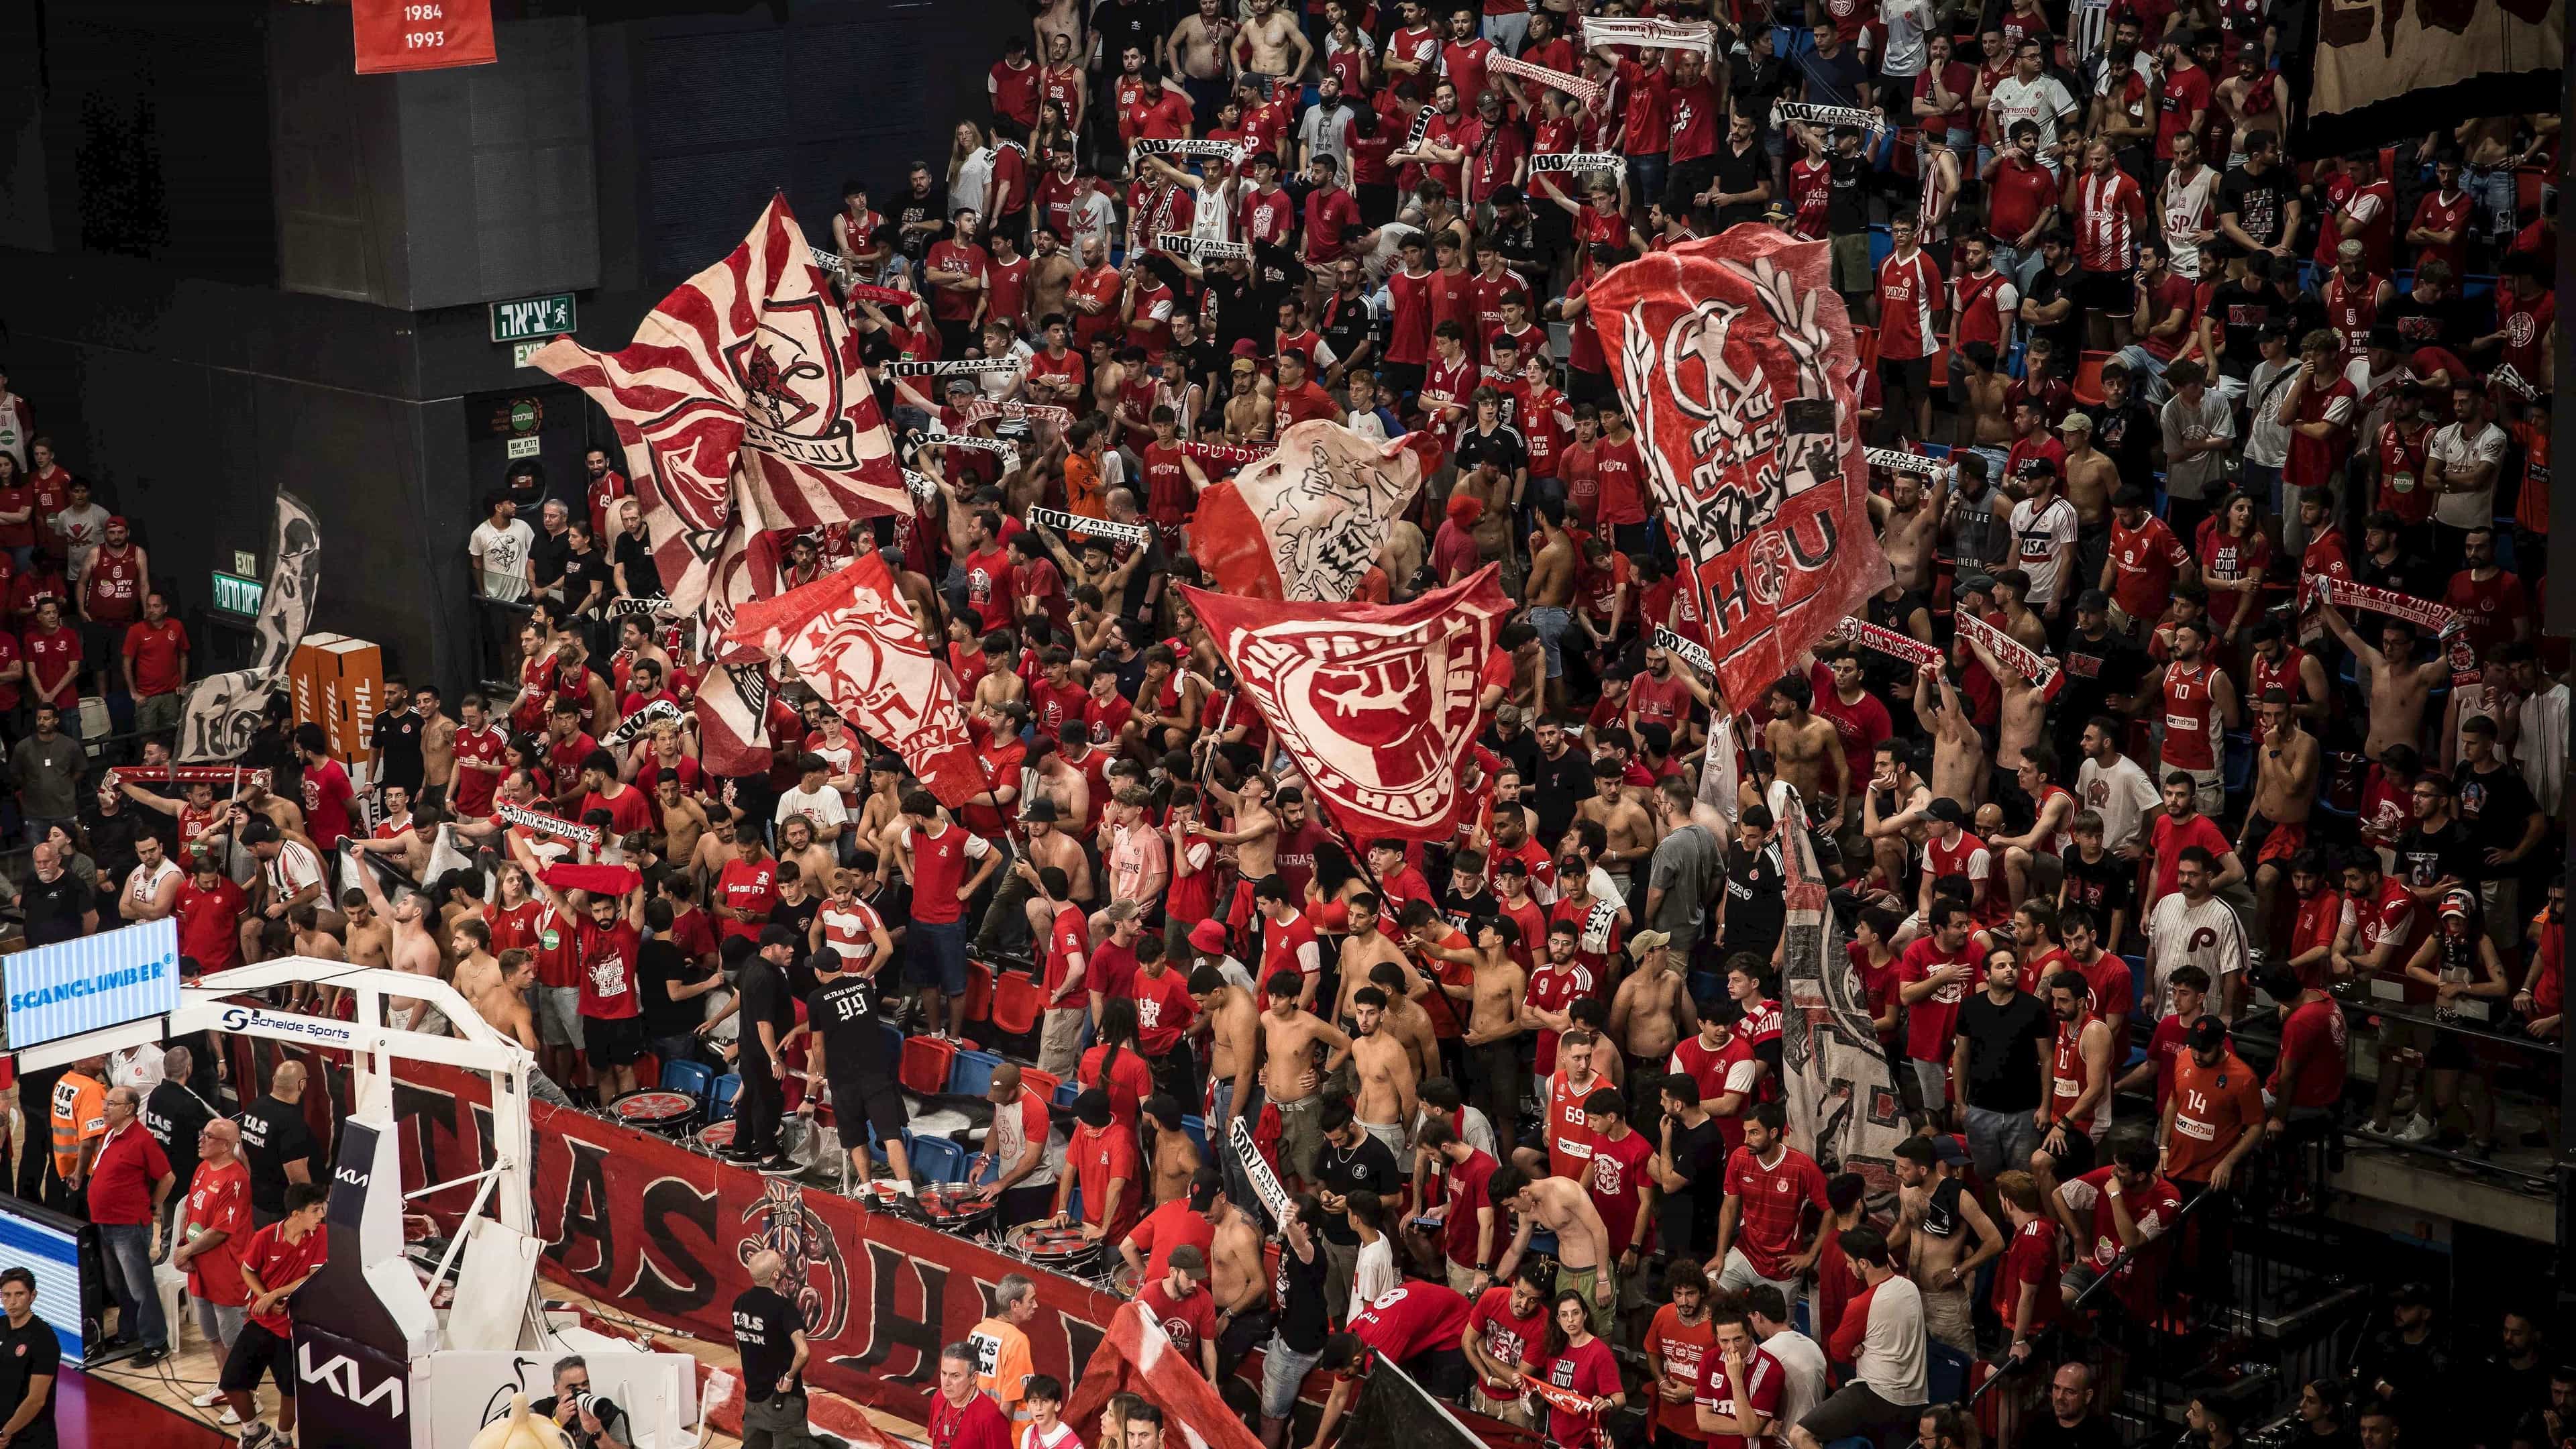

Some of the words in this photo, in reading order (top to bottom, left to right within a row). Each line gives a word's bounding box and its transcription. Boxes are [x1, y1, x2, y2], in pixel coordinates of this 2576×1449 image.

[404, 4, 443, 21] 1984
[405, 31, 444, 48] 1993
[1051, 86, 1064, 98] 32
[1122, 91, 1136, 103] 69
[1244, 136, 1260, 151] SP
[1806, 188, 1828, 199] rkia
[2169, 215, 2191, 233] SP
[858, 235, 865, 246] 5
[1205, 241, 1245, 252] ANTI
[1204, 250, 1246, 260] MACCABI
[500, 300, 552, 337] יציאה
[2347, 309, 2356, 325] 5
[2351, 330, 2370, 338] GIVE
[2353, 337, 2361, 345] IT
[955, 366, 1018, 374] MACCABI
[957, 358, 1018, 367] ANTI
[512, 411, 533, 423] שלמה
[511, 441, 521, 449] אש
[524, 439, 537, 447] דלת
[1882, 450, 1938, 466] ANTI
[2393, 447, 2405, 464] 7
[39, 493, 53, 506] 41
[1087, 528, 1140, 544] MACCABI
[1089, 521, 1140, 535] ANTI
[2021, 538, 2047, 555] ISA
[236, 552, 256, 576] EXIT
[2332, 578, 2371, 598] אביב
[2377, 588, 2400, 604] תל
[2351, 597, 2392, 613] אימפריה
[2398, 608, 2427, 625] הפועל
[34, 641, 46, 653] 15
[1976, 624, 1995, 647] OR
[2000, 637, 2039, 678] DEAD
[2175, 683, 2190, 700] 10
[296, 674, 309, 729] TIHL
[328, 680, 342, 753] STIHL
[356, 678, 372, 750] STIHL
[185, 822, 202, 836] 10
[2187, 926, 2217, 952] P
[598, 975, 624, 989] DEFINE
[1538, 977, 1549, 995] 9
[599, 983, 627, 998] YOURSELF
[823, 987, 845, 1001] ULTRAS
[846, 982, 867, 995] HAPOEL
[836, 992, 868, 1022] 99
[250, 1012, 305, 1032] Schelde
[307, 1024, 350, 1040] Sports
[2188, 1089, 2207, 1115] 14
[1565, 1105, 1585, 1126] 69
[2187, 1122, 2214, 1137] שלמה
[1260, 1165, 1285, 1203] ANTI
[1374, 1287, 1409, 1310] 8
[1555, 1359, 1576, 1371] אהבה
[1551, 1371, 1573, 1388] לעולם
